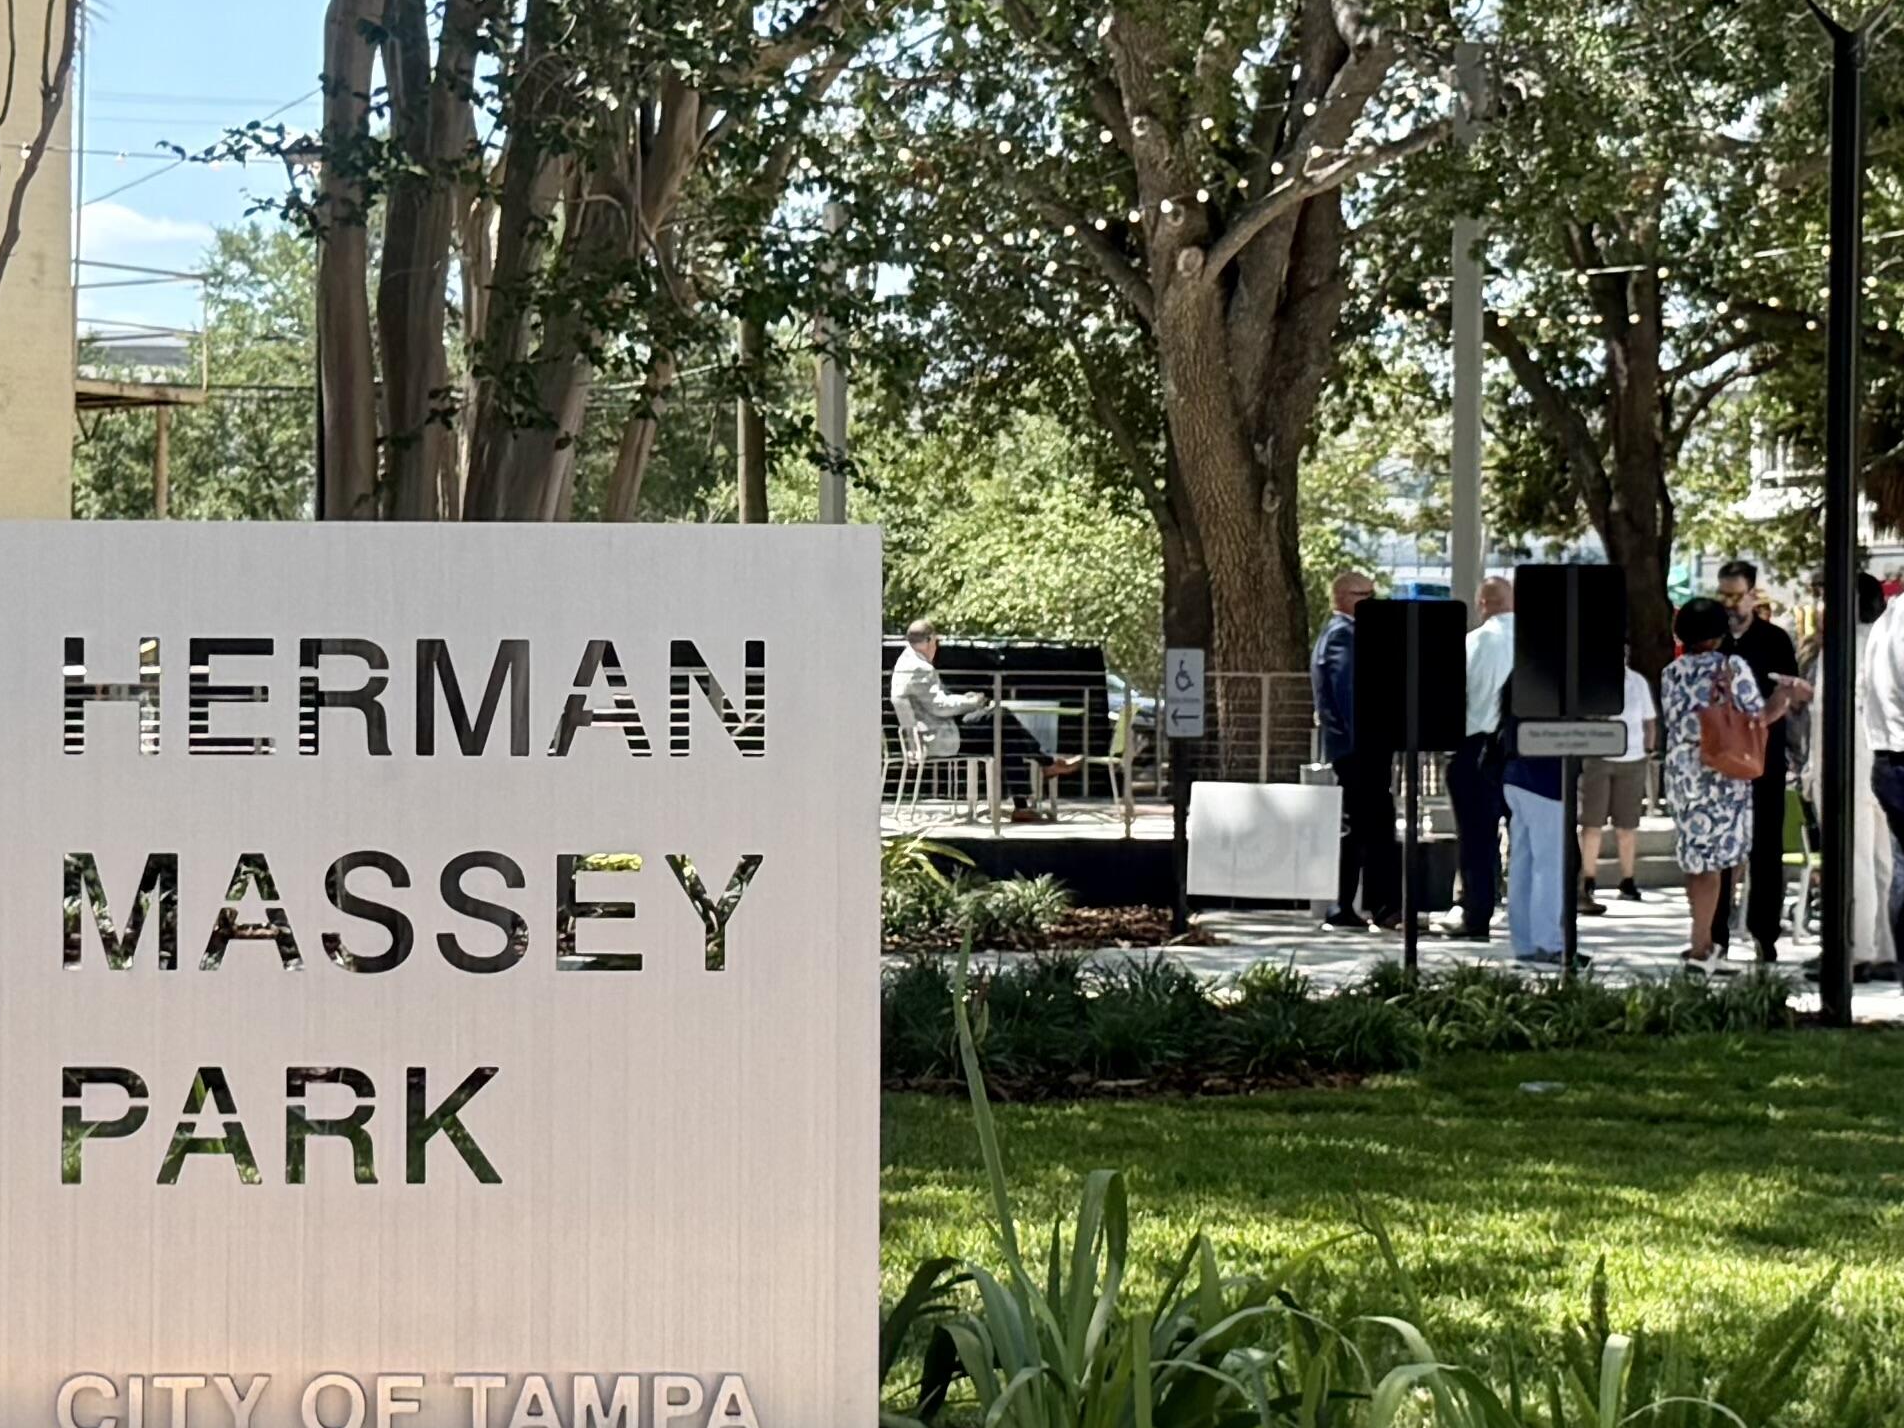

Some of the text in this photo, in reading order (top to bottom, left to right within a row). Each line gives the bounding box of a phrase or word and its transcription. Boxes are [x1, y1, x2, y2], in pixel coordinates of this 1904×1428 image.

[61, 635, 767, 758] HERMAN
[62, 851, 764, 974] MASSEY
[60, 1066, 503, 1184] PARK
